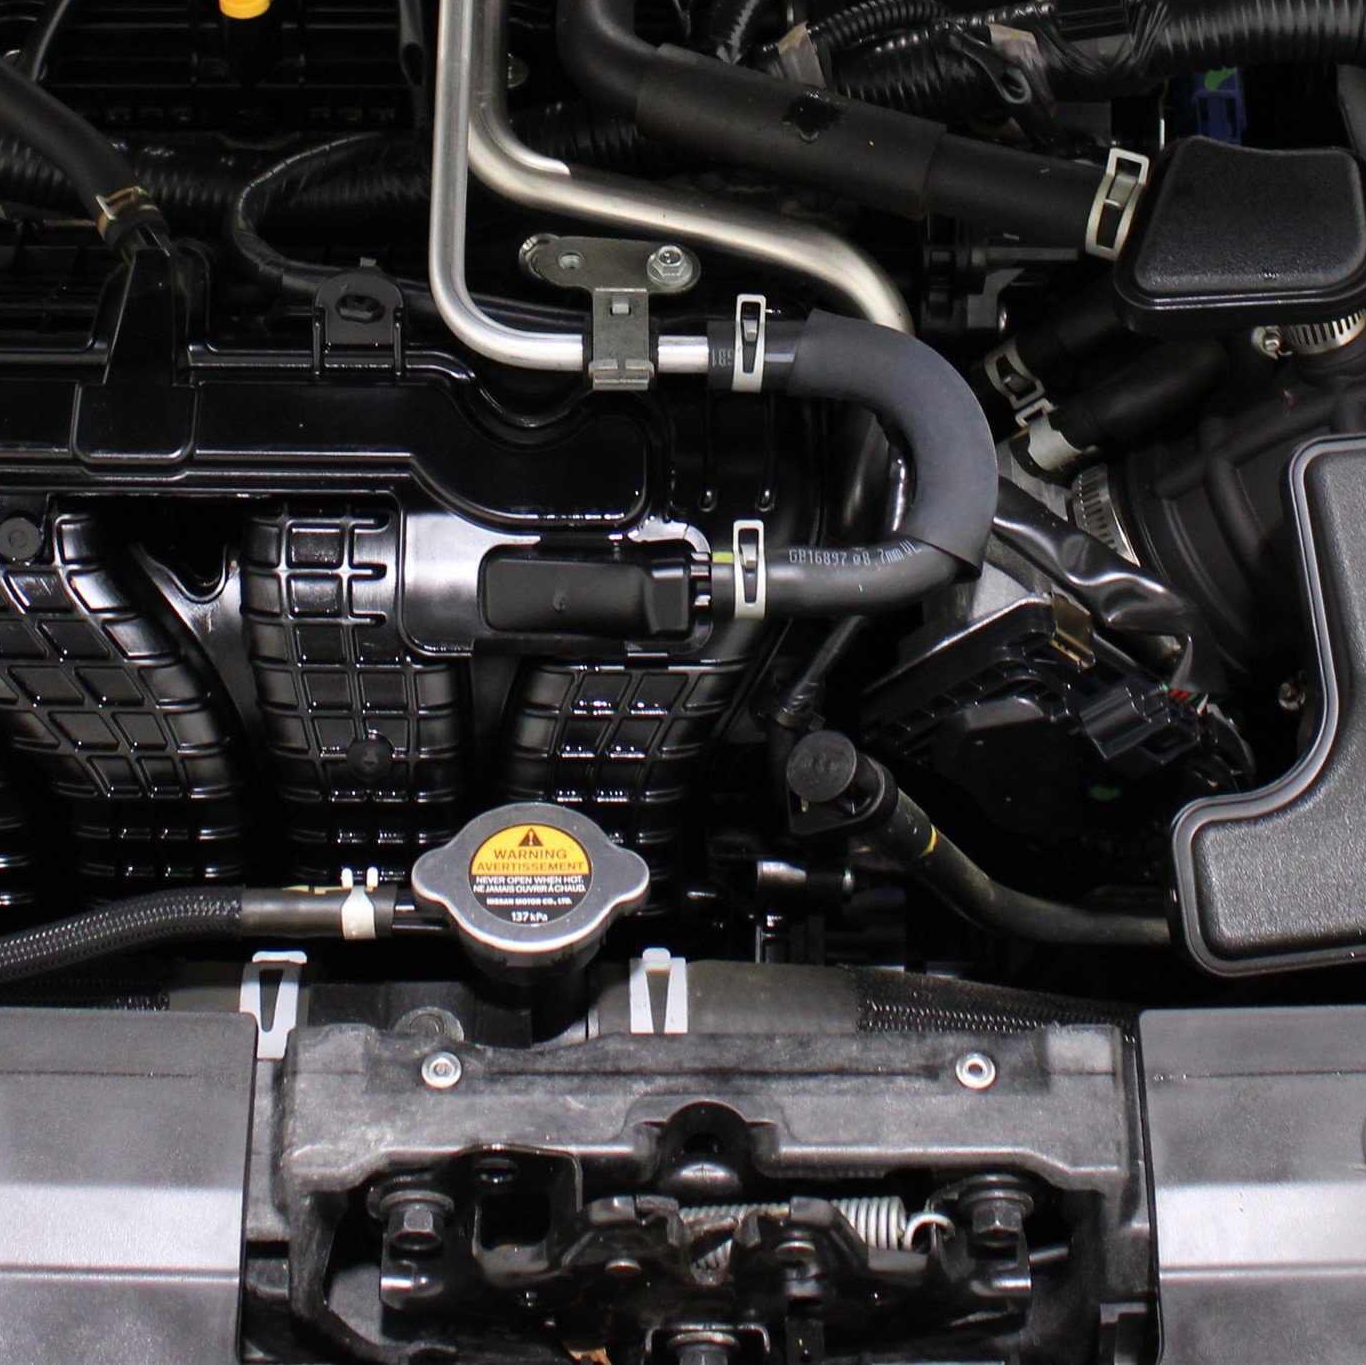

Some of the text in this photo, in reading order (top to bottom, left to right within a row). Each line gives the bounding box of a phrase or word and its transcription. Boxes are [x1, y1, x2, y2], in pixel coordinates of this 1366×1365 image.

[494, 848, 567, 860] WARNING
[476, 862, 584, 872] AVERTISSEMENT
[476, 875, 584, 884] NEVER OPEN WHEN HOT.
[473, 884, 485, 894] NE
[485, 884, 514, 894] JAMAIS
[515, 884, 547, 894] OUVRIR
[486, 897, 514, 906] NISSAN
[515, 897, 542, 906] MOTOR
[511, 911, 549, 922] 137 kPa
